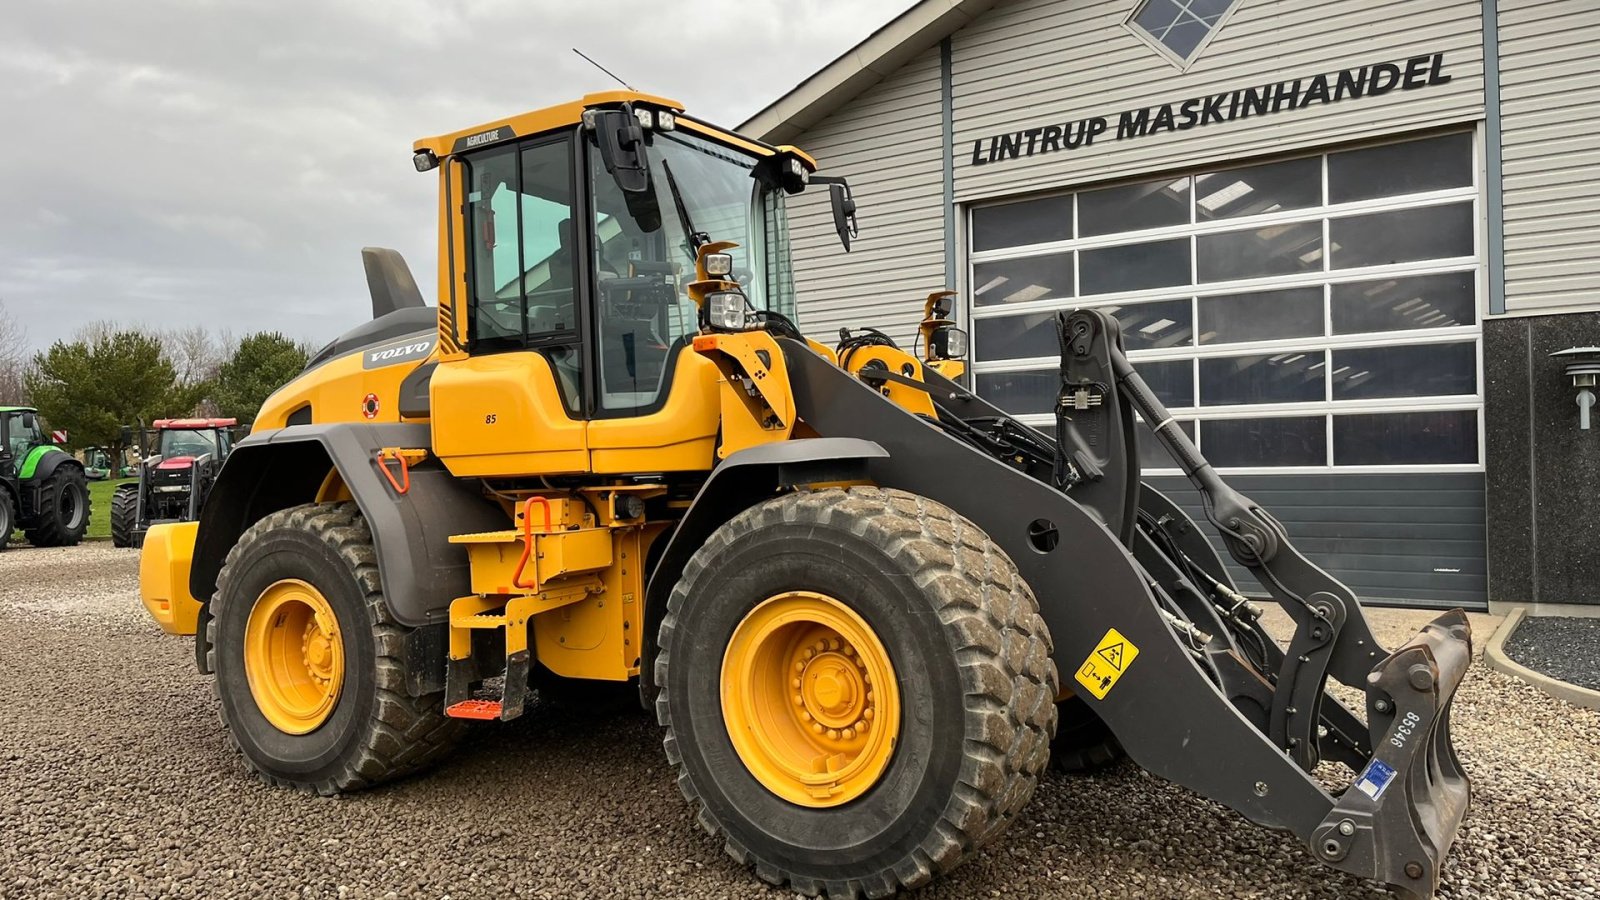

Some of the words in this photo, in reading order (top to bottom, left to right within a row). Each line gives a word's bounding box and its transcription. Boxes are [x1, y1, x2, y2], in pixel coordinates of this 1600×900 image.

[972, 116, 1107, 165] LINTRUP
[1116, 53, 1451, 140] MASKINHANDEL
[466, 130, 499, 147] AGRICULTURE
[371, 341, 430, 362] VOLVO
[485, 414, 496, 424] 85
[1390, 711, 1420, 748] 85346
